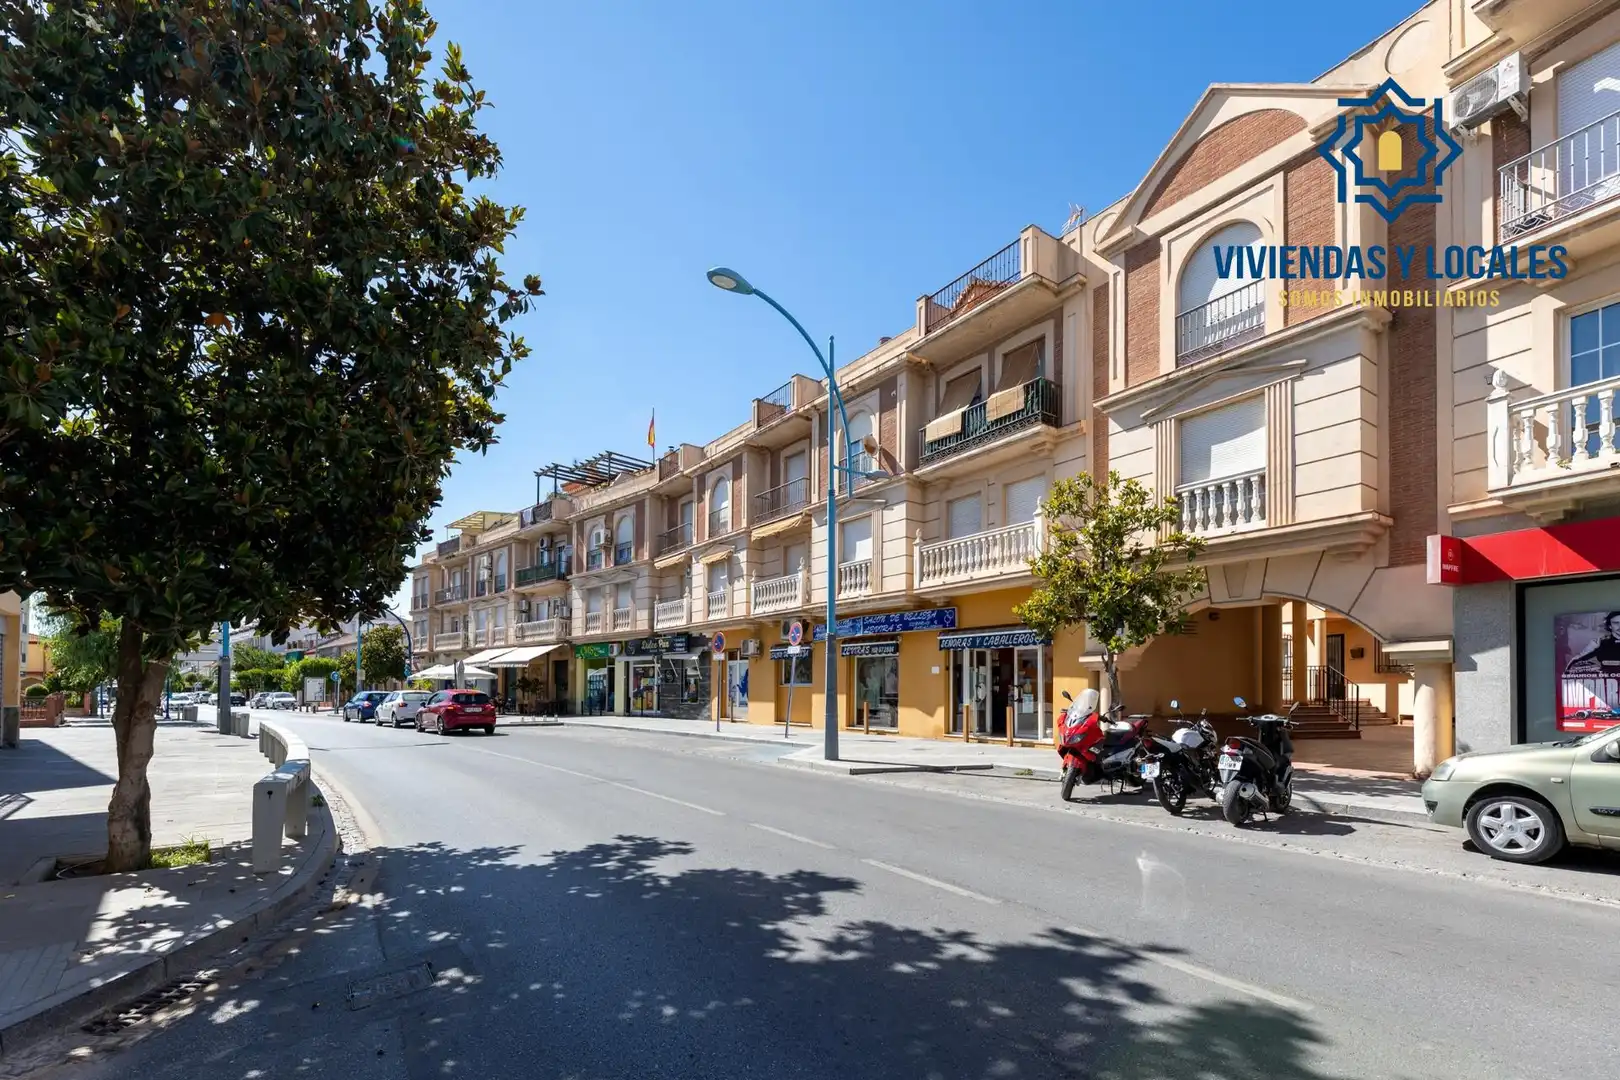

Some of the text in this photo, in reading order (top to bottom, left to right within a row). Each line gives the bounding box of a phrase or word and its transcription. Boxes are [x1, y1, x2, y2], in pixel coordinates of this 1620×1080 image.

[1442, 563, 1459, 572] MAPFRE
[975, 637, 982, 646] Y
[983, 633, 1036, 646] CABALLEROS
[1561, 678, 1620, 708] IMPAR
